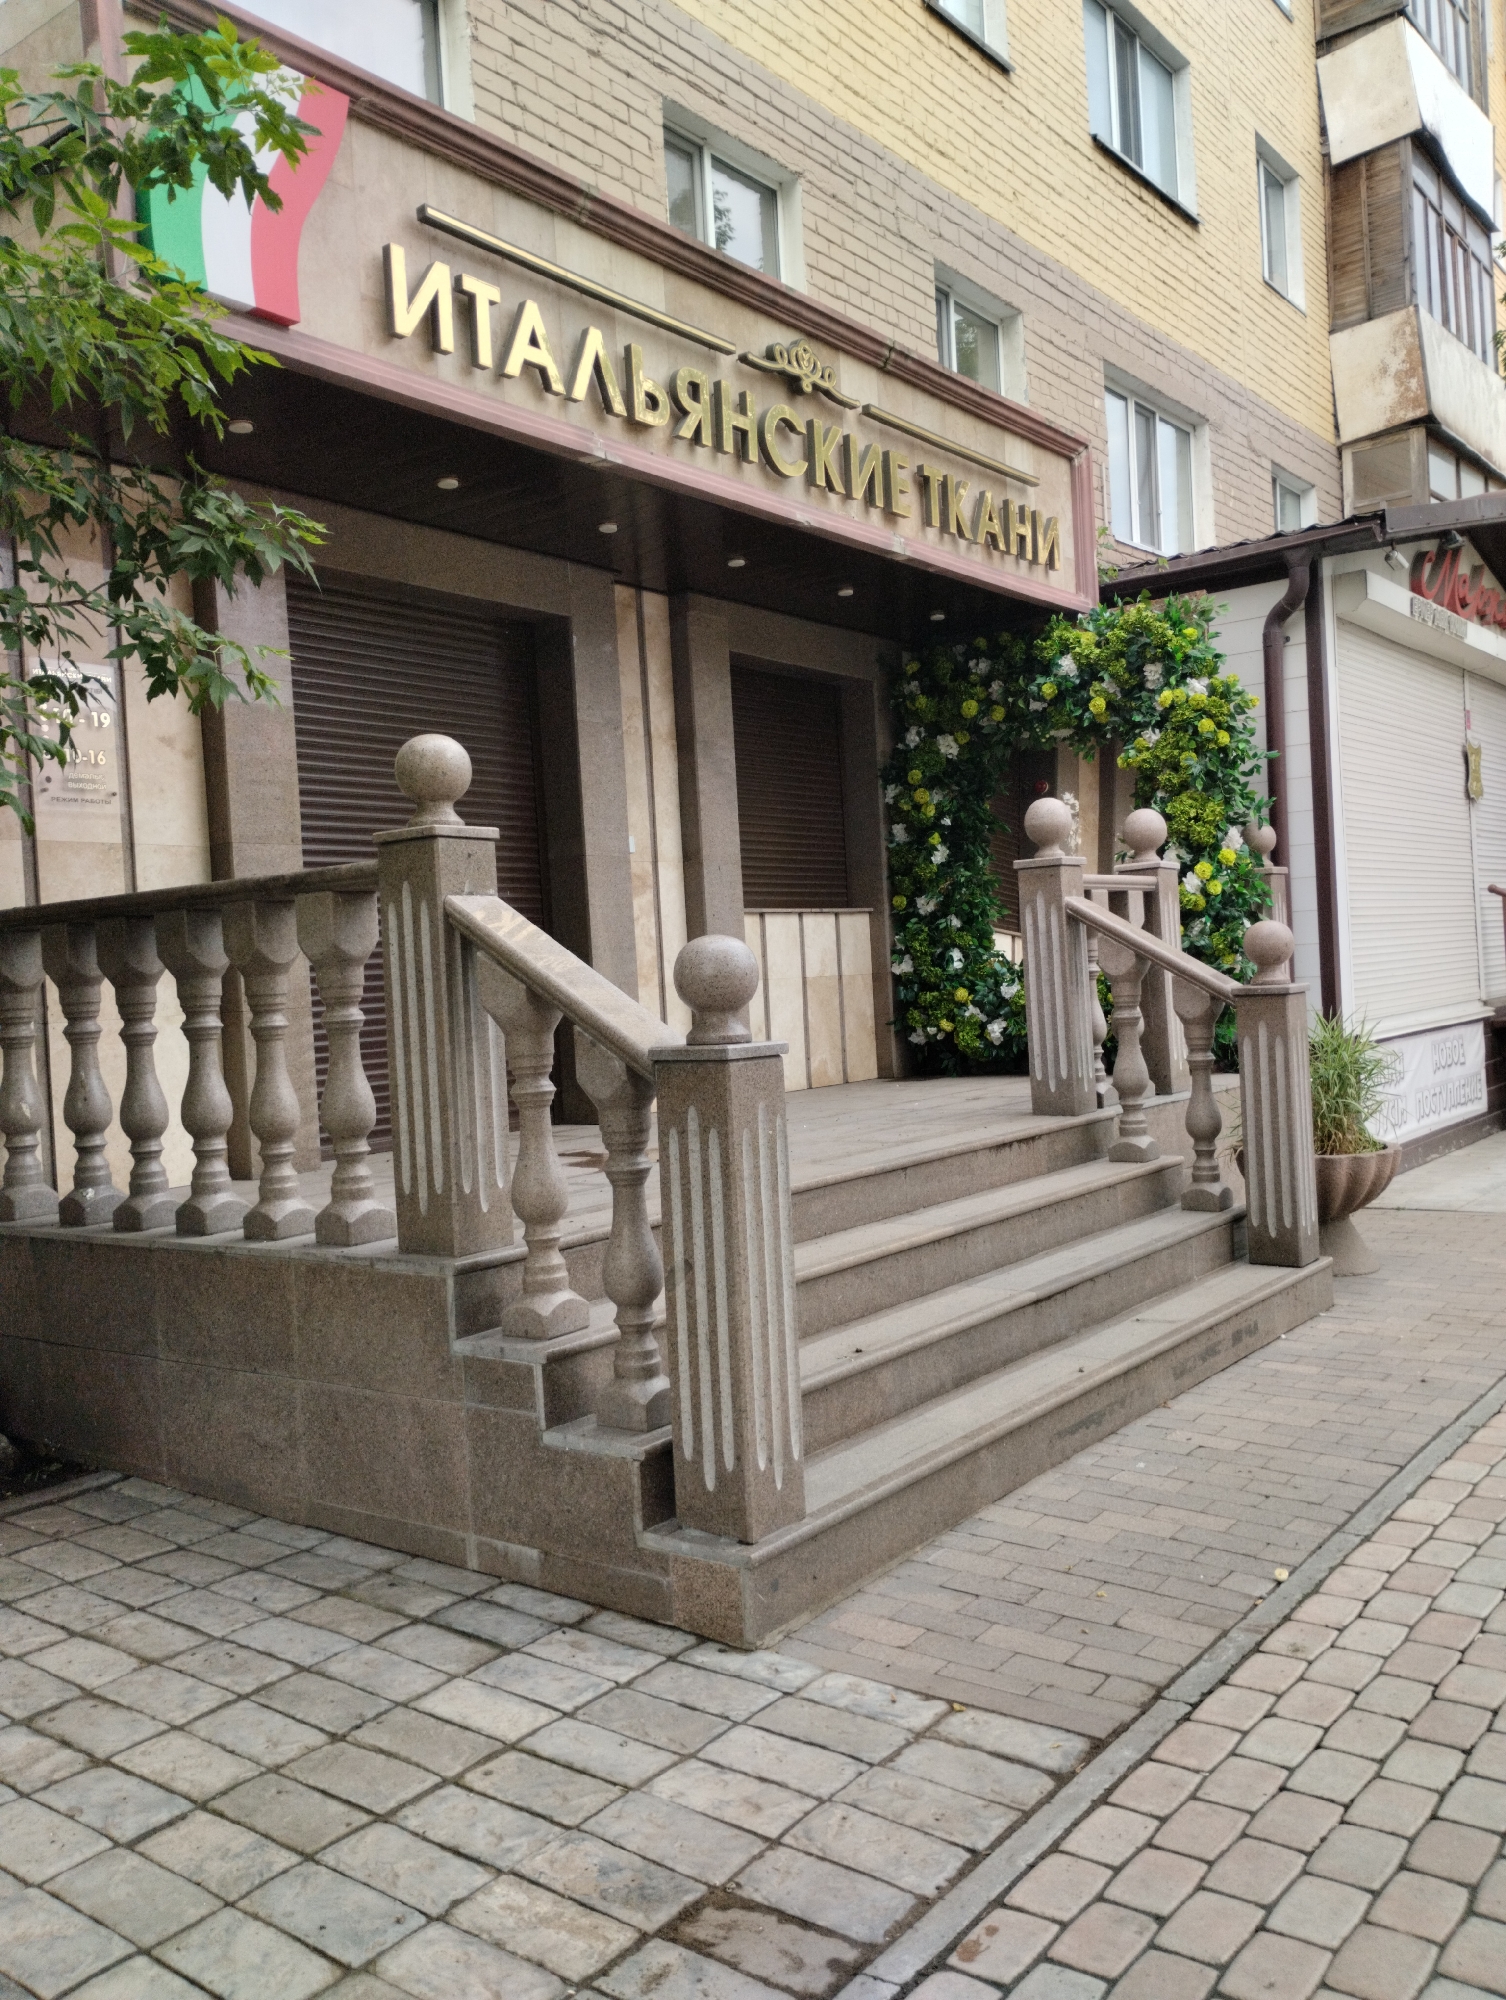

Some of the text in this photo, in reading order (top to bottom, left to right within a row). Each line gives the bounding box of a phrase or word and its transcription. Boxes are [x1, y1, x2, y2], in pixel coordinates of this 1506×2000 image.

[382, 241, 1062, 572] ИТАЛЬЯНСКИЕ ТКАНИ
[91, 711, 111, 728] 19
[67, 781, 107, 790] выходной
[80, 797, 112, 805] РАБОТЫ
[1432, 1037, 1467, 1074] НОВОЕ
[1414, 1072, 1483, 1123] ПОСТУПЛЕНИЕ
